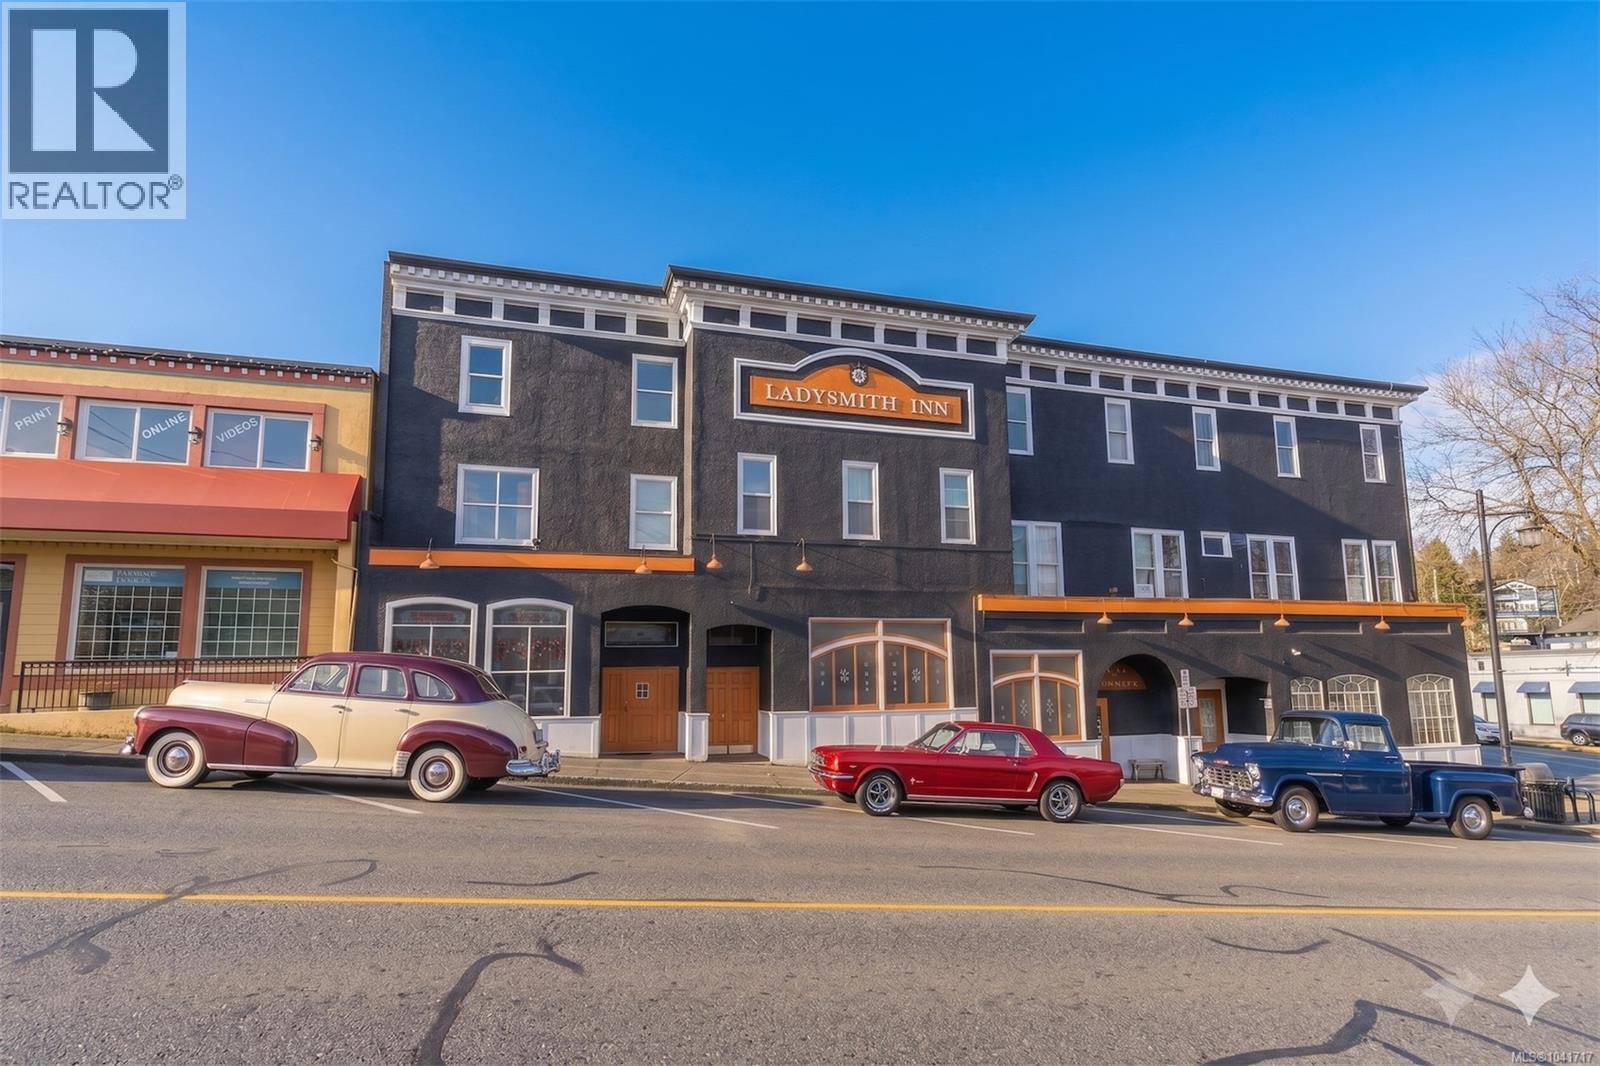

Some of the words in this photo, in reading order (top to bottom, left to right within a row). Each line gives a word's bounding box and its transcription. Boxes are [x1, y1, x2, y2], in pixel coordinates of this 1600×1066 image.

[765, 383, 897, 412] LADYSMITH
[911, 398, 950, 416] INN
[14, 406, 52, 430] PRINT
[142, 411, 187, 439] ONLINE
[215, 417, 258, 442] VIDEOS
